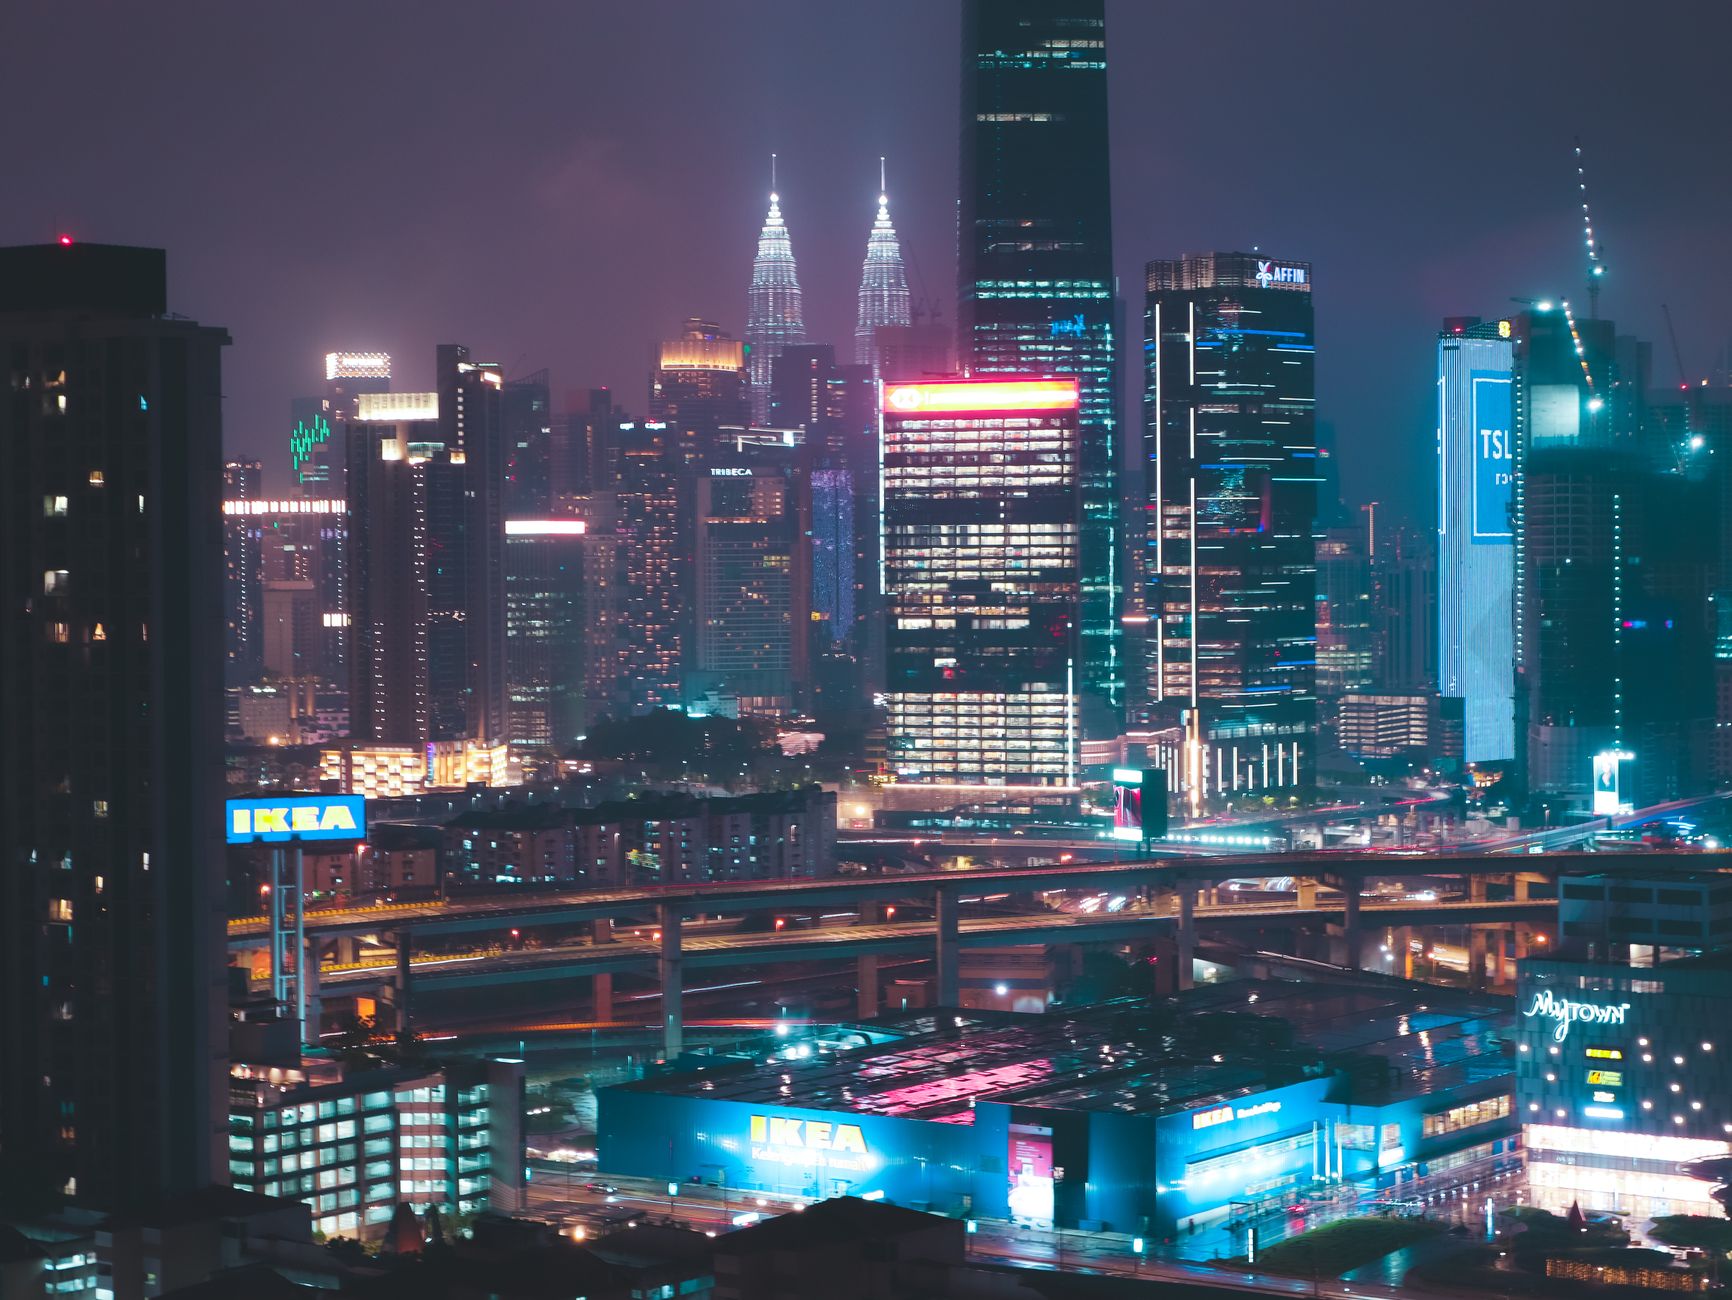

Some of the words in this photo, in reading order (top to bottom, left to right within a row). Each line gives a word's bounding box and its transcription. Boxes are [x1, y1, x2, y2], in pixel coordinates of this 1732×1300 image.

[1274, 267, 1305, 283] AFFIN
[710, 468, 752, 476] TRIBECA
[233, 805, 357, 834] IKEA
[1192, 1104, 1235, 1130] IKEA
[750, 1114, 869, 1153] IKEA
